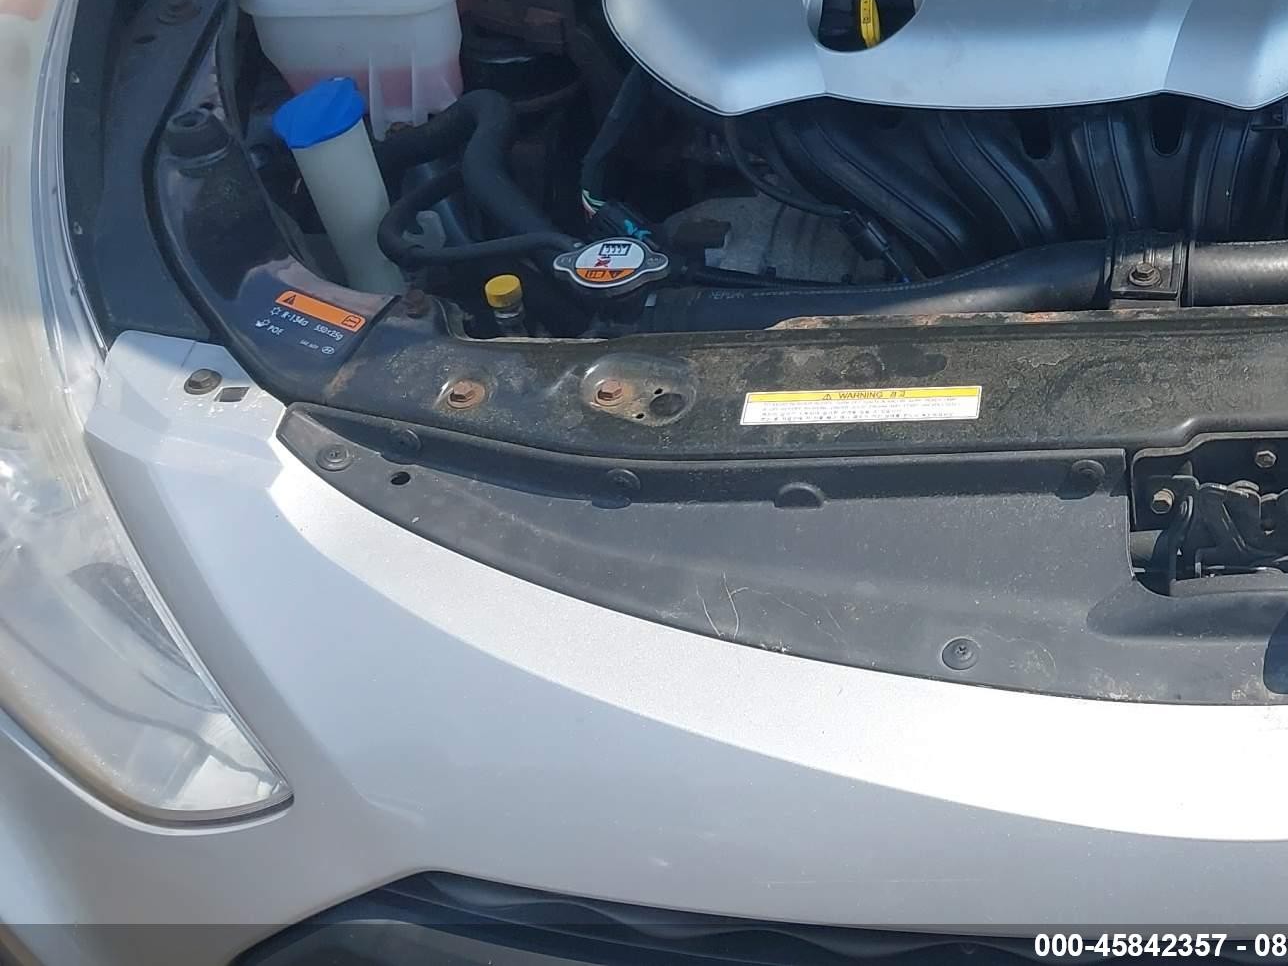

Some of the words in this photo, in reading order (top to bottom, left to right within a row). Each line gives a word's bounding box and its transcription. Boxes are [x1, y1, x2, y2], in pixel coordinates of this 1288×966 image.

[281, 311, 309, 327] R-134a
[267, 325, 285, 336] POE
[838, 391, 883, 400] WARNING
